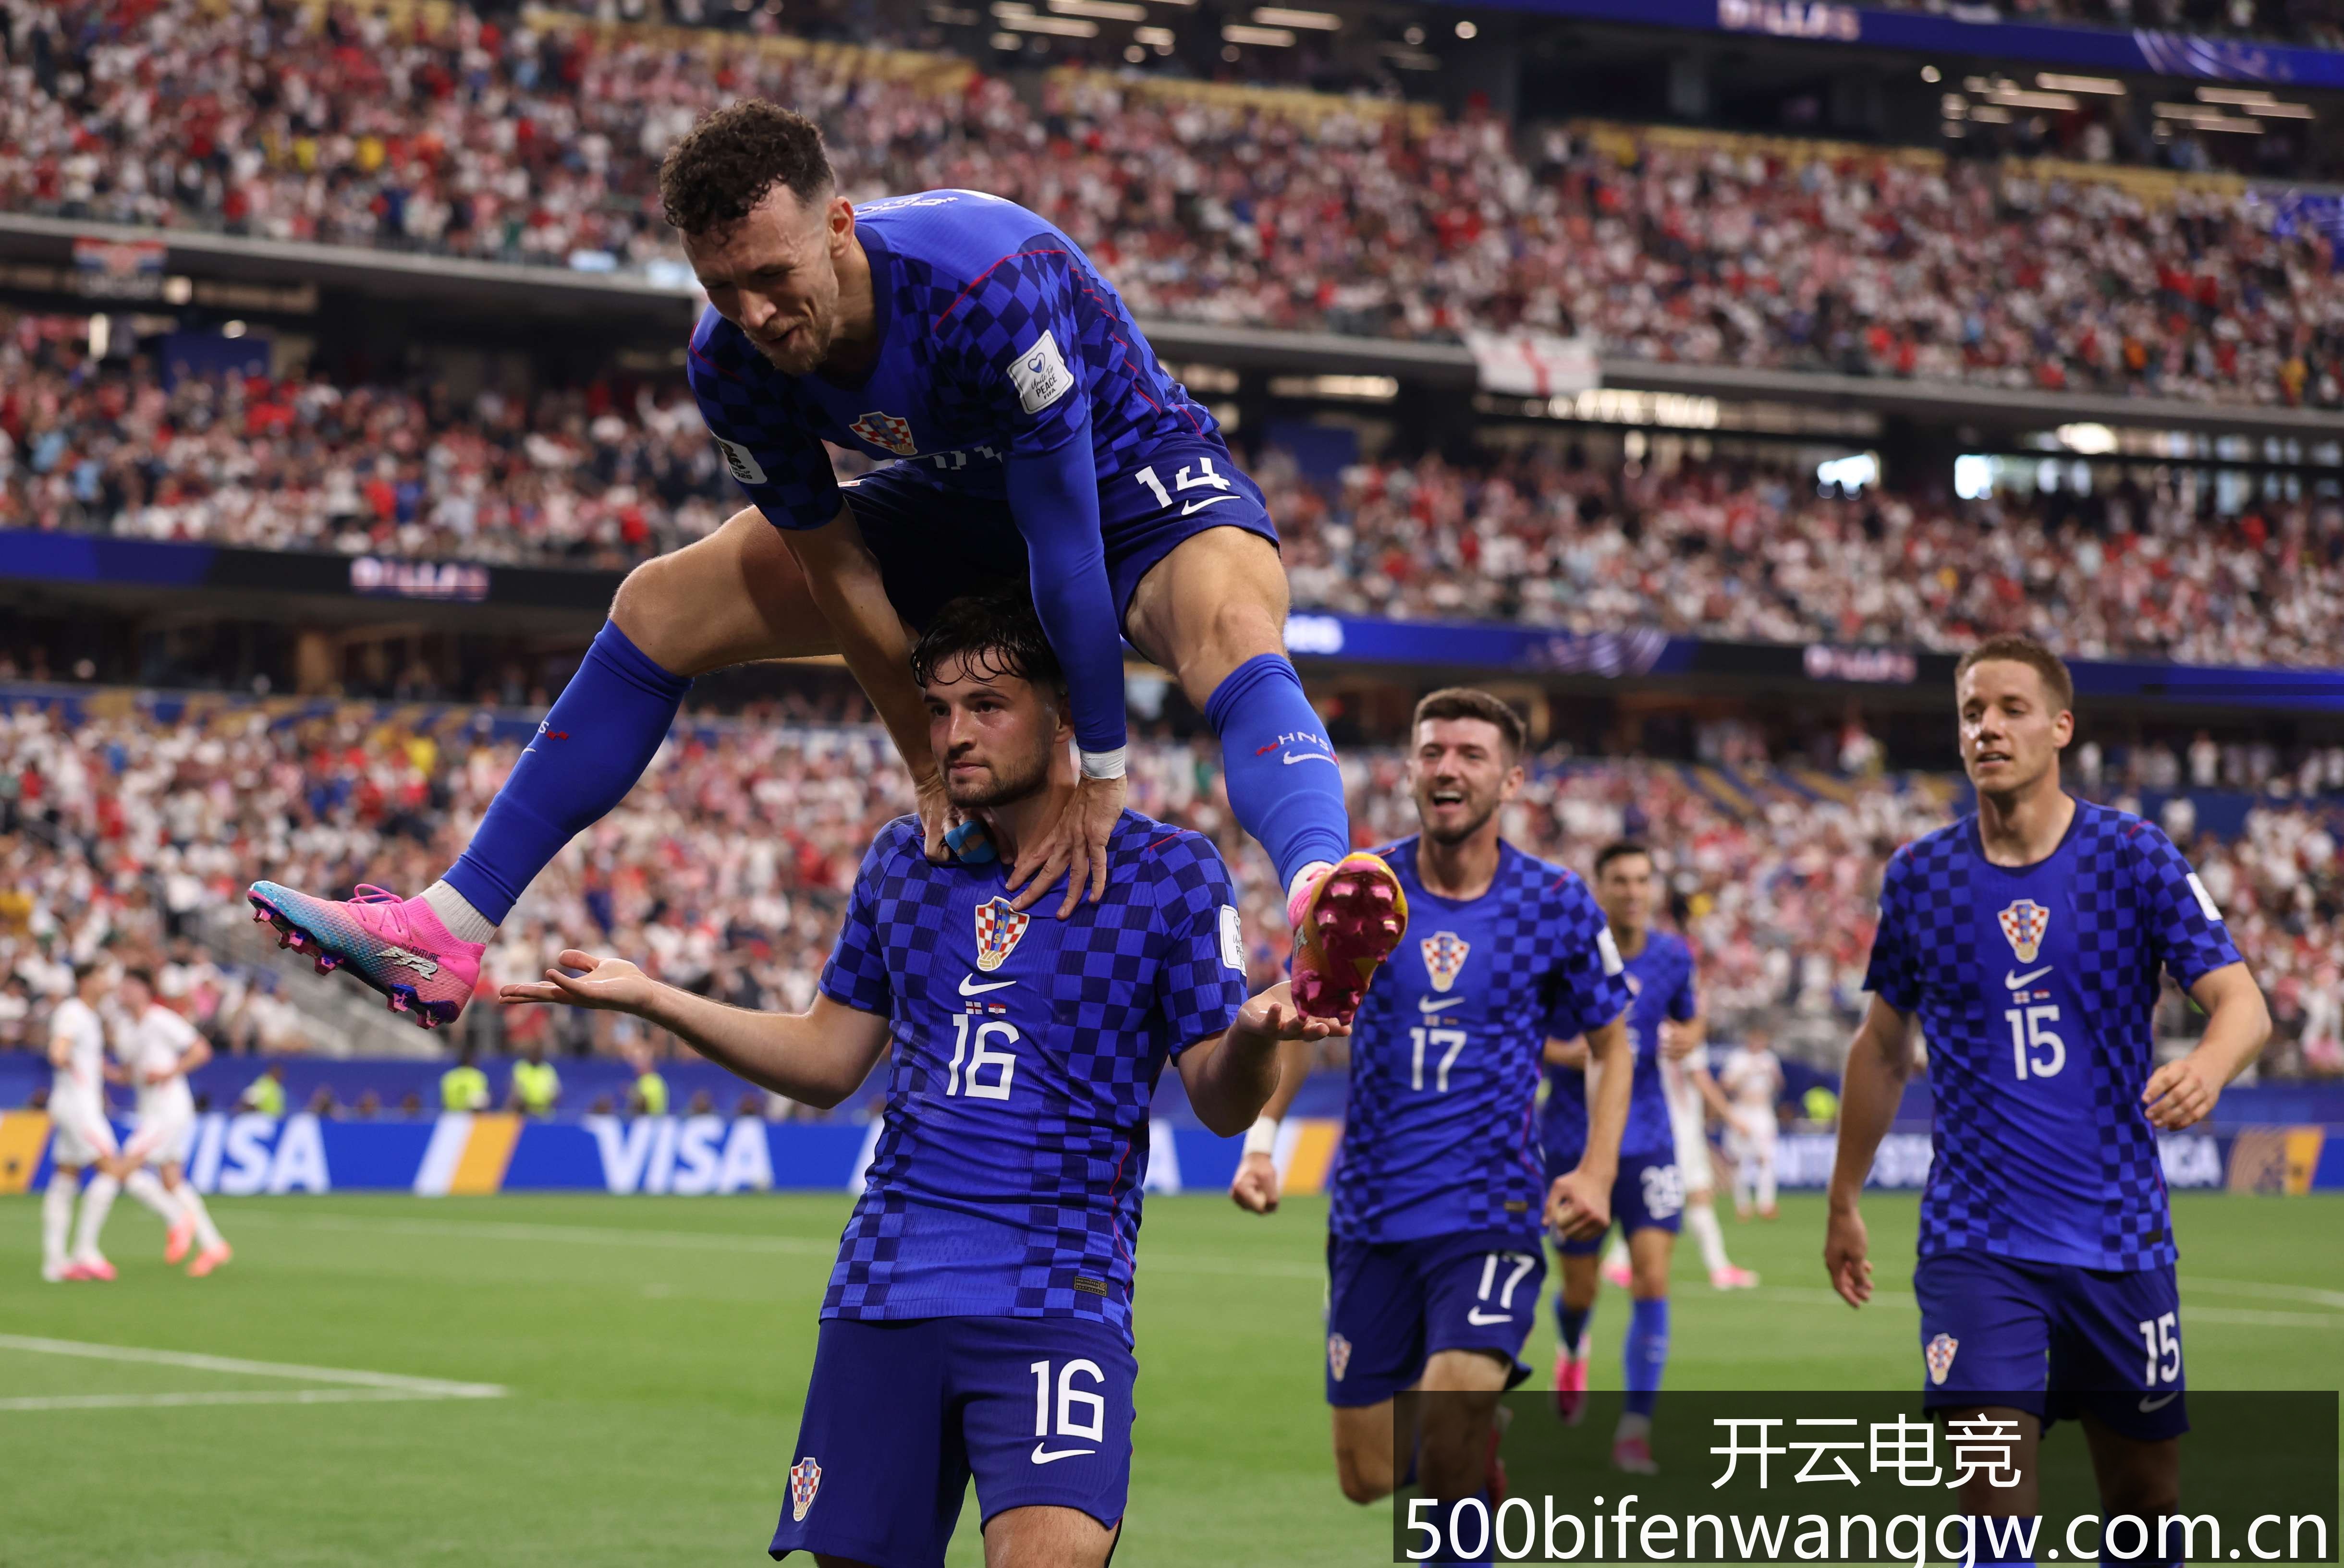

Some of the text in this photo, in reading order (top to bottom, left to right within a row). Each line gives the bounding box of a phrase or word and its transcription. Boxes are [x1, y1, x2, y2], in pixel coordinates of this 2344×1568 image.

[1036, 373, 1057, 397] PEACE
[1043, 388, 1056, 400] FIFA
[1135, 457, 1231, 508] 14
[1278, 731, 1329, 752] HNS
[411, 946, 441, 962] FUTURE
[946, 1014, 1020, 1100] 16
[1409, 1027, 1467, 1093] 17
[2004, 1005, 2065, 1081] 15
[186, 1111, 331, 1194] ISA
[579, 1113, 775, 1195] VISA
[1477, 1252, 1536, 1310] 17
[2139, 1312, 2181, 1387] 15
[1031, 1359, 1105, 1443] 16
